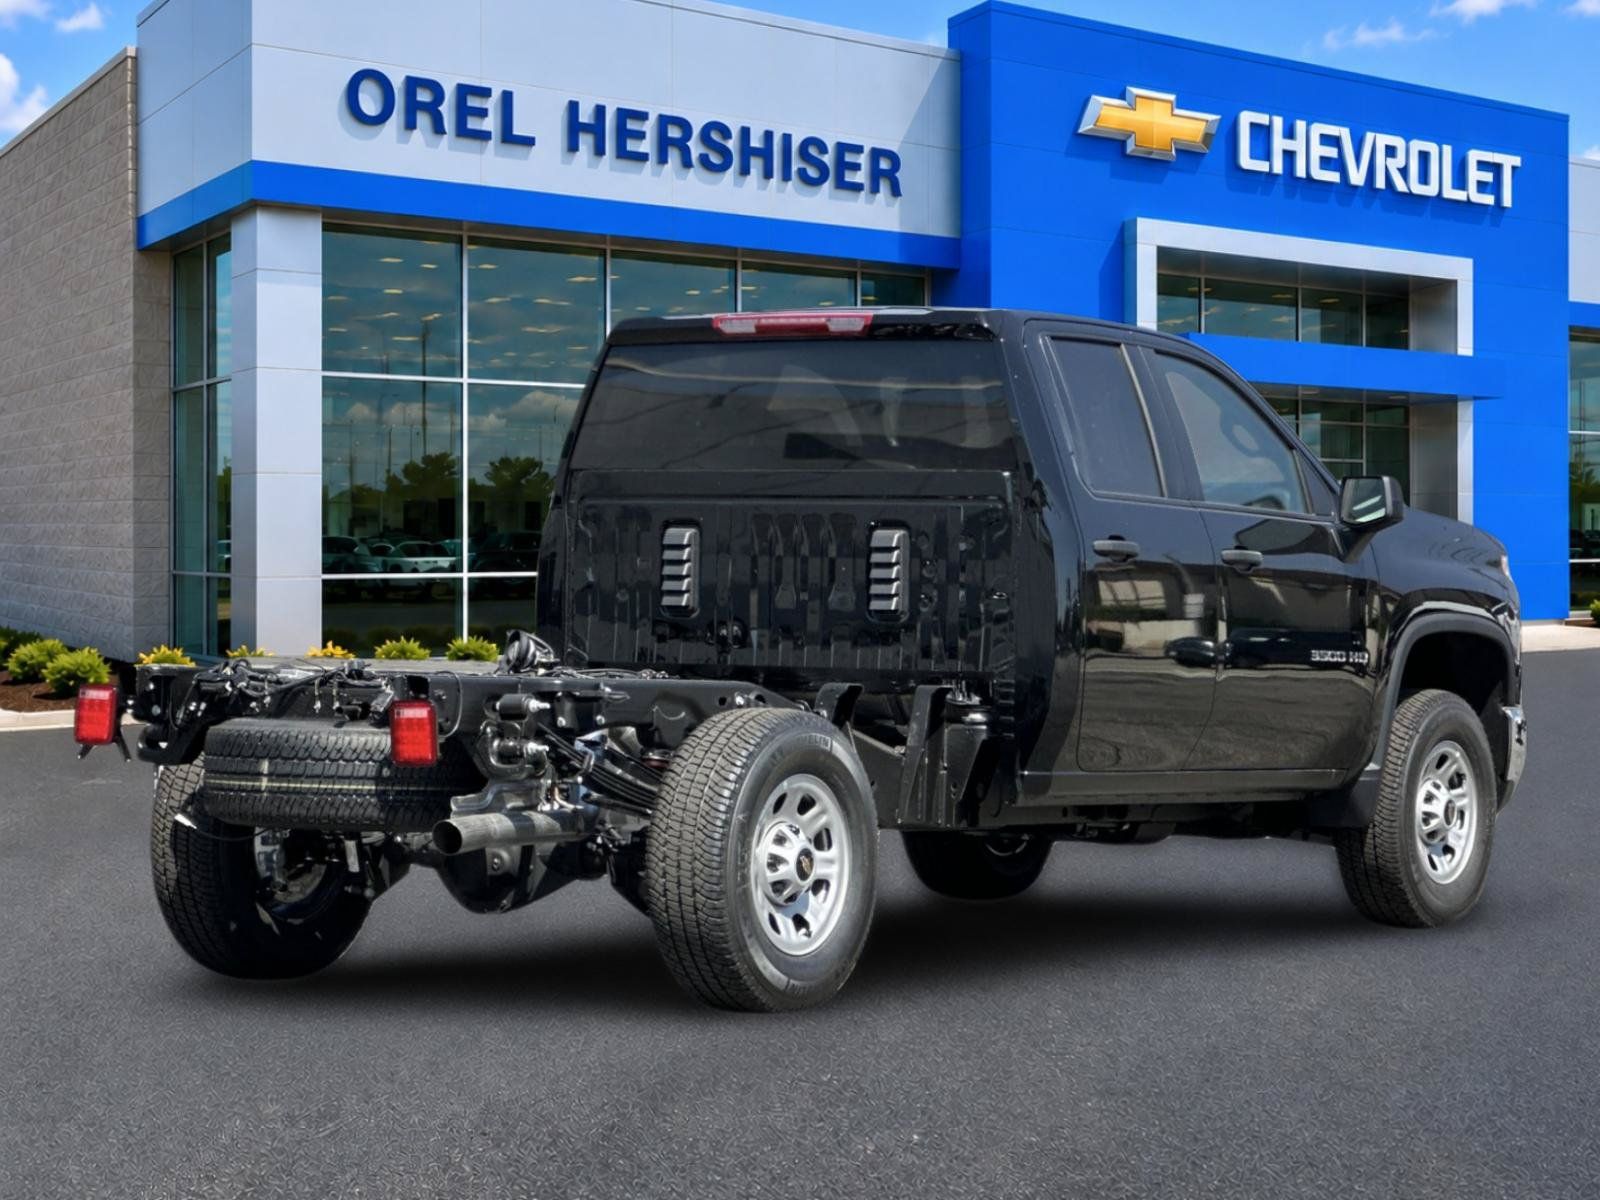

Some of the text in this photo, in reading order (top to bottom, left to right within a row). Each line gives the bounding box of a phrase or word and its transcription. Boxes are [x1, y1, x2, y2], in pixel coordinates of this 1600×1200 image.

[346, 69, 902, 197] OREL HERSHISER
[1237, 110, 1521, 208] CHEVROLET
